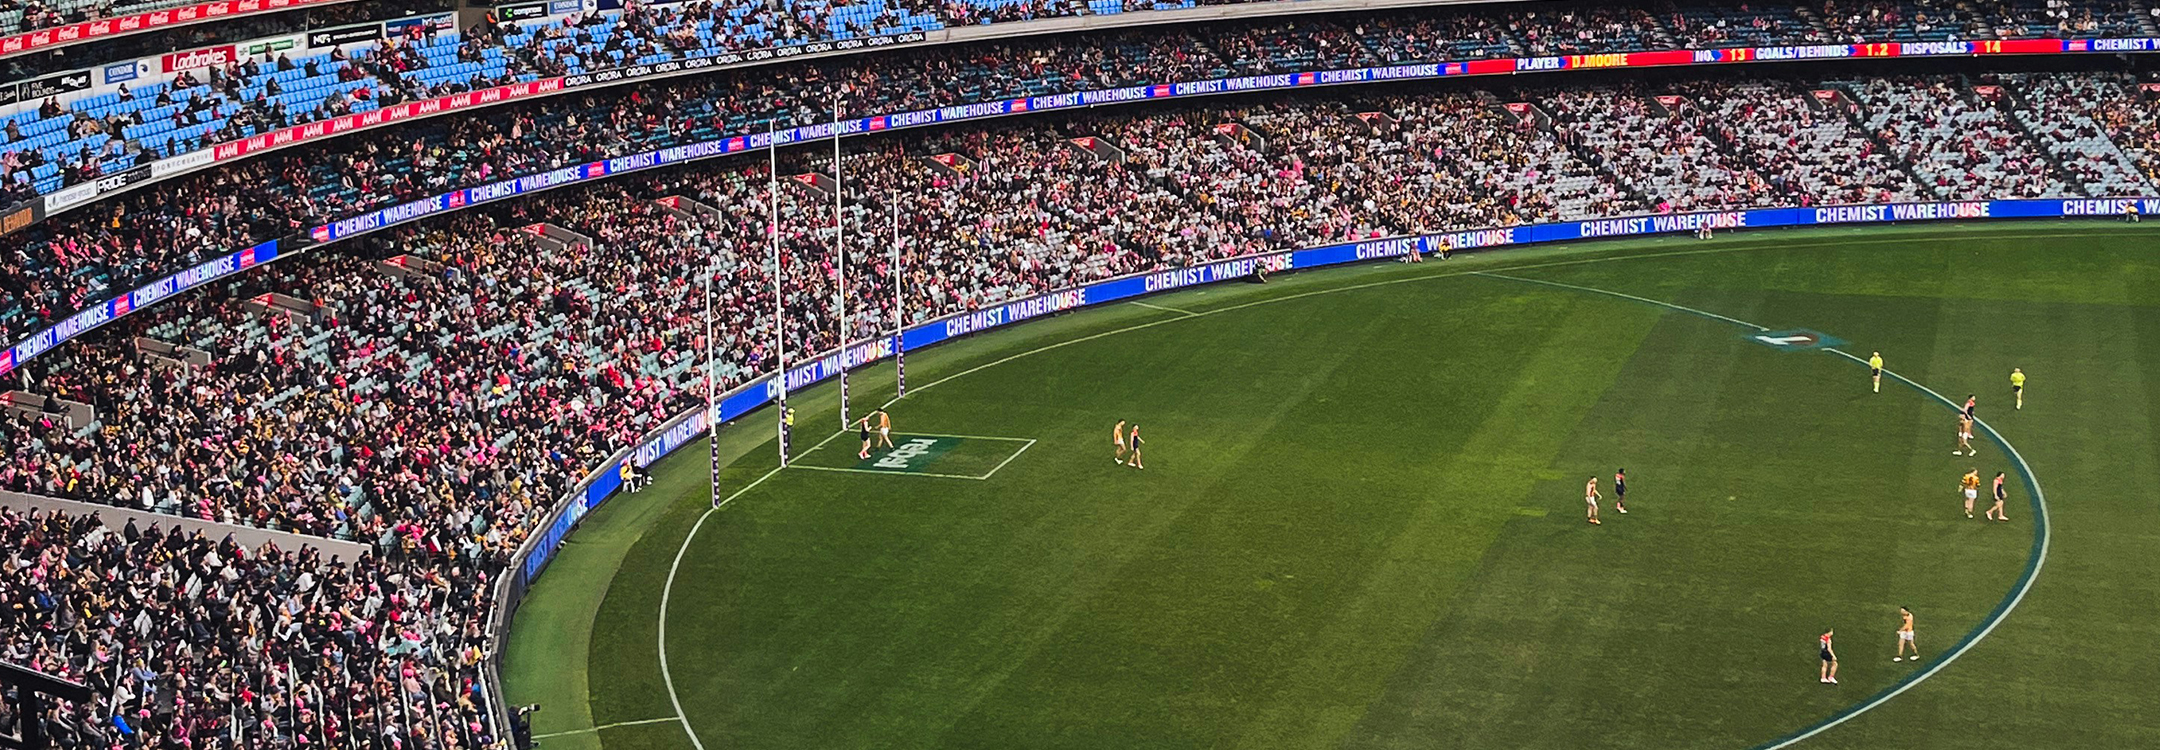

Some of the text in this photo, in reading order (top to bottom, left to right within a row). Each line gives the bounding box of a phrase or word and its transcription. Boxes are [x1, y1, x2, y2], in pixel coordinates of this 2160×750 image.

[837, 39, 863, 49] ORORA
[868, 36, 894, 46] ORORA
[898, 33, 924, 43] ORORA
[777, 47, 801, 57] ORORA
[806, 43, 832, 53] ORORA
[1517, 57, 1560, 70] PLAYER
[1572, 54, 1628, 68] D.MOORE
[1730, 48, 1746, 61] 13
[1756, 45, 1848, 60] GOALS/BEHINDS
[1866, 44, 1888, 56] 1.2
[1903, 41, 1968, 54] DISPOSALS
[1985, 40, 2000, 53] 14
[2094, 39, 2149, 50] CHEMIST
[172, 48, 226, 70] Ladbrokes
[685, 58, 711, 68] ORORA
[716, 54, 742, 64] ORORA
[626, 66, 651, 77] ORORA
[656, 62, 680, 72] ORORA
[1321, 68, 1368, 83] CHEMIST
[1372, 64, 1438, 79] WAREHOUSE
[566, 76, 591, 86] ORORA
[596, 71, 622, 81] ORORA
[510, 84, 529, 97] AAMI
[538, 80, 558, 92] AAMI
[1176, 80, 1222, 95] CHEMIST
[1226, 74, 1291, 90] WAREHOUSE
[450, 94, 470, 108] AAMI
[481, 90, 500, 102] AAMI
[1033, 92, 1080, 110] CHEMIST
[1083, 86, 1146, 104] WAREHOUSE
[390, 105, 409, 119] AAMI
[419, 100, 440, 113] AAMI
[362, 111, 383, 125] AAMI
[891, 110, 936, 127] CHEMIST
[941, 102, 1004, 120] WAREHOUSE
[303, 123, 323, 138] AAMI
[333, 117, 353, 132] AAMI
[246, 136, 265, 152] AAMI
[273, 129, 292, 145] AAMI
[750, 129, 796, 148] CHEMIST
[218, 143, 238, 158] AAMI
[610, 152, 655, 172] CHEMIST
[659, 141, 721, 162] WAREHOUSE
[97, 173, 127, 193] PRIDE
[471, 182, 516, 202] CHEMIST
[520, 166, 580, 190] WAREHOUSE
[335, 212, 380, 237] CHEMIST
[384, 196, 442, 222] WAREHOUSE
[1816, 201, 1990, 223] CHEMIST WAREHOUSE
[1581, 218, 1648, 237] CHEMIST
[134, 278, 174, 307] CHEMIST
[176, 256, 234, 288] WAREHOUSE
[1146, 264, 1205, 292] CHEMIST
[946, 288, 1086, 338] CHEMIST WAREHOUSE
[16, 328, 54, 362] CHEMIST
[55, 305, 109, 341] WAREHOUSE
[873, 438, 938, 468] rebel
